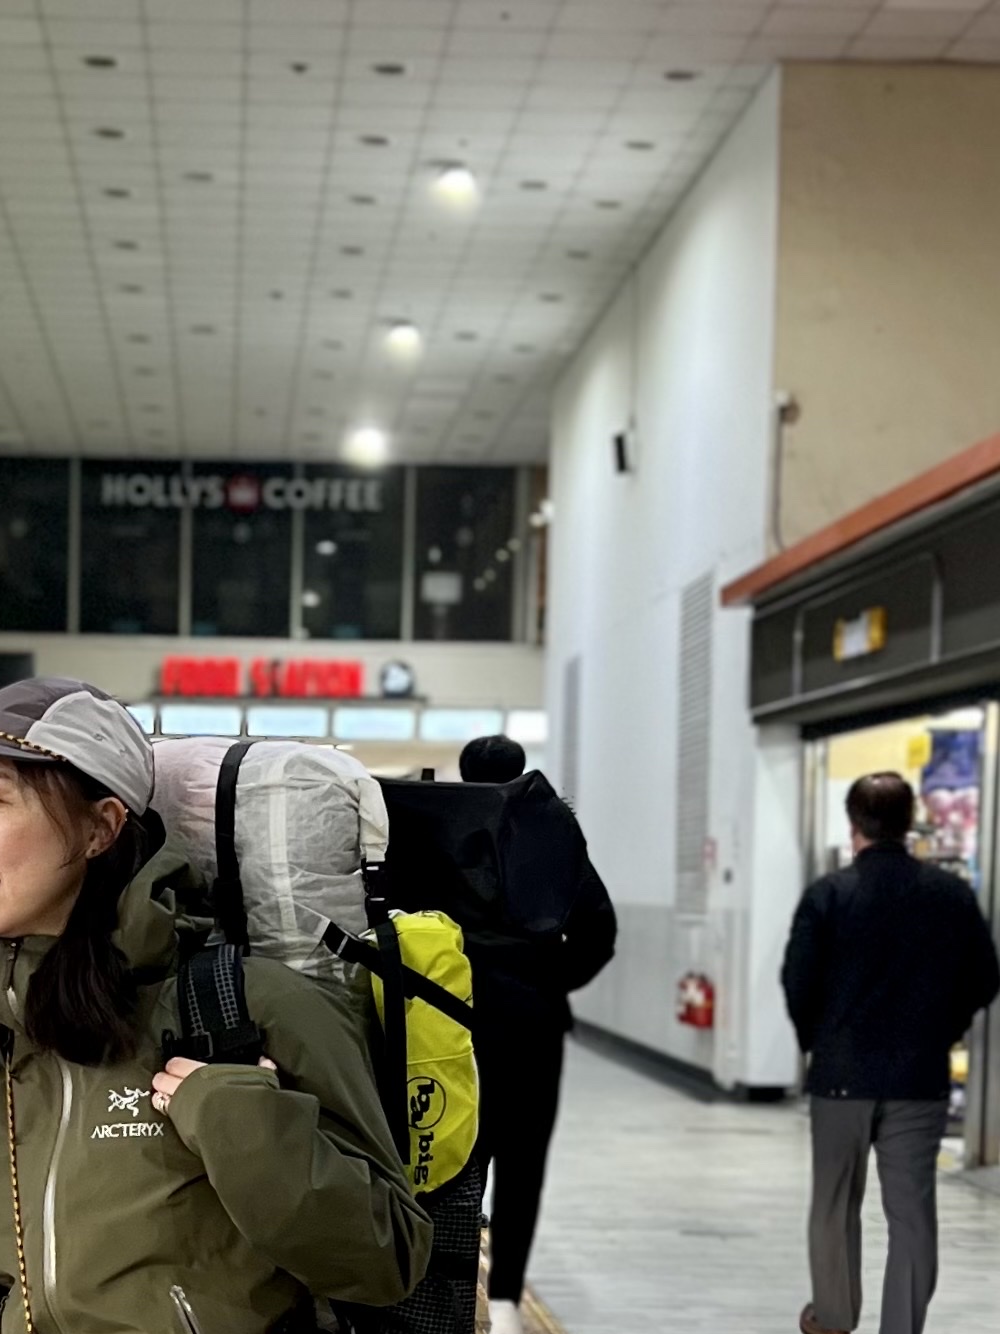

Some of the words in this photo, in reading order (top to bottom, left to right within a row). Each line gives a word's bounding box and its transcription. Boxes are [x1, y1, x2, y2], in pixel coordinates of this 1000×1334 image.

[102, 473, 225, 510] HOLLYS
[262, 477, 382, 513] COFFEE
[414, 1131, 434, 1186] big
